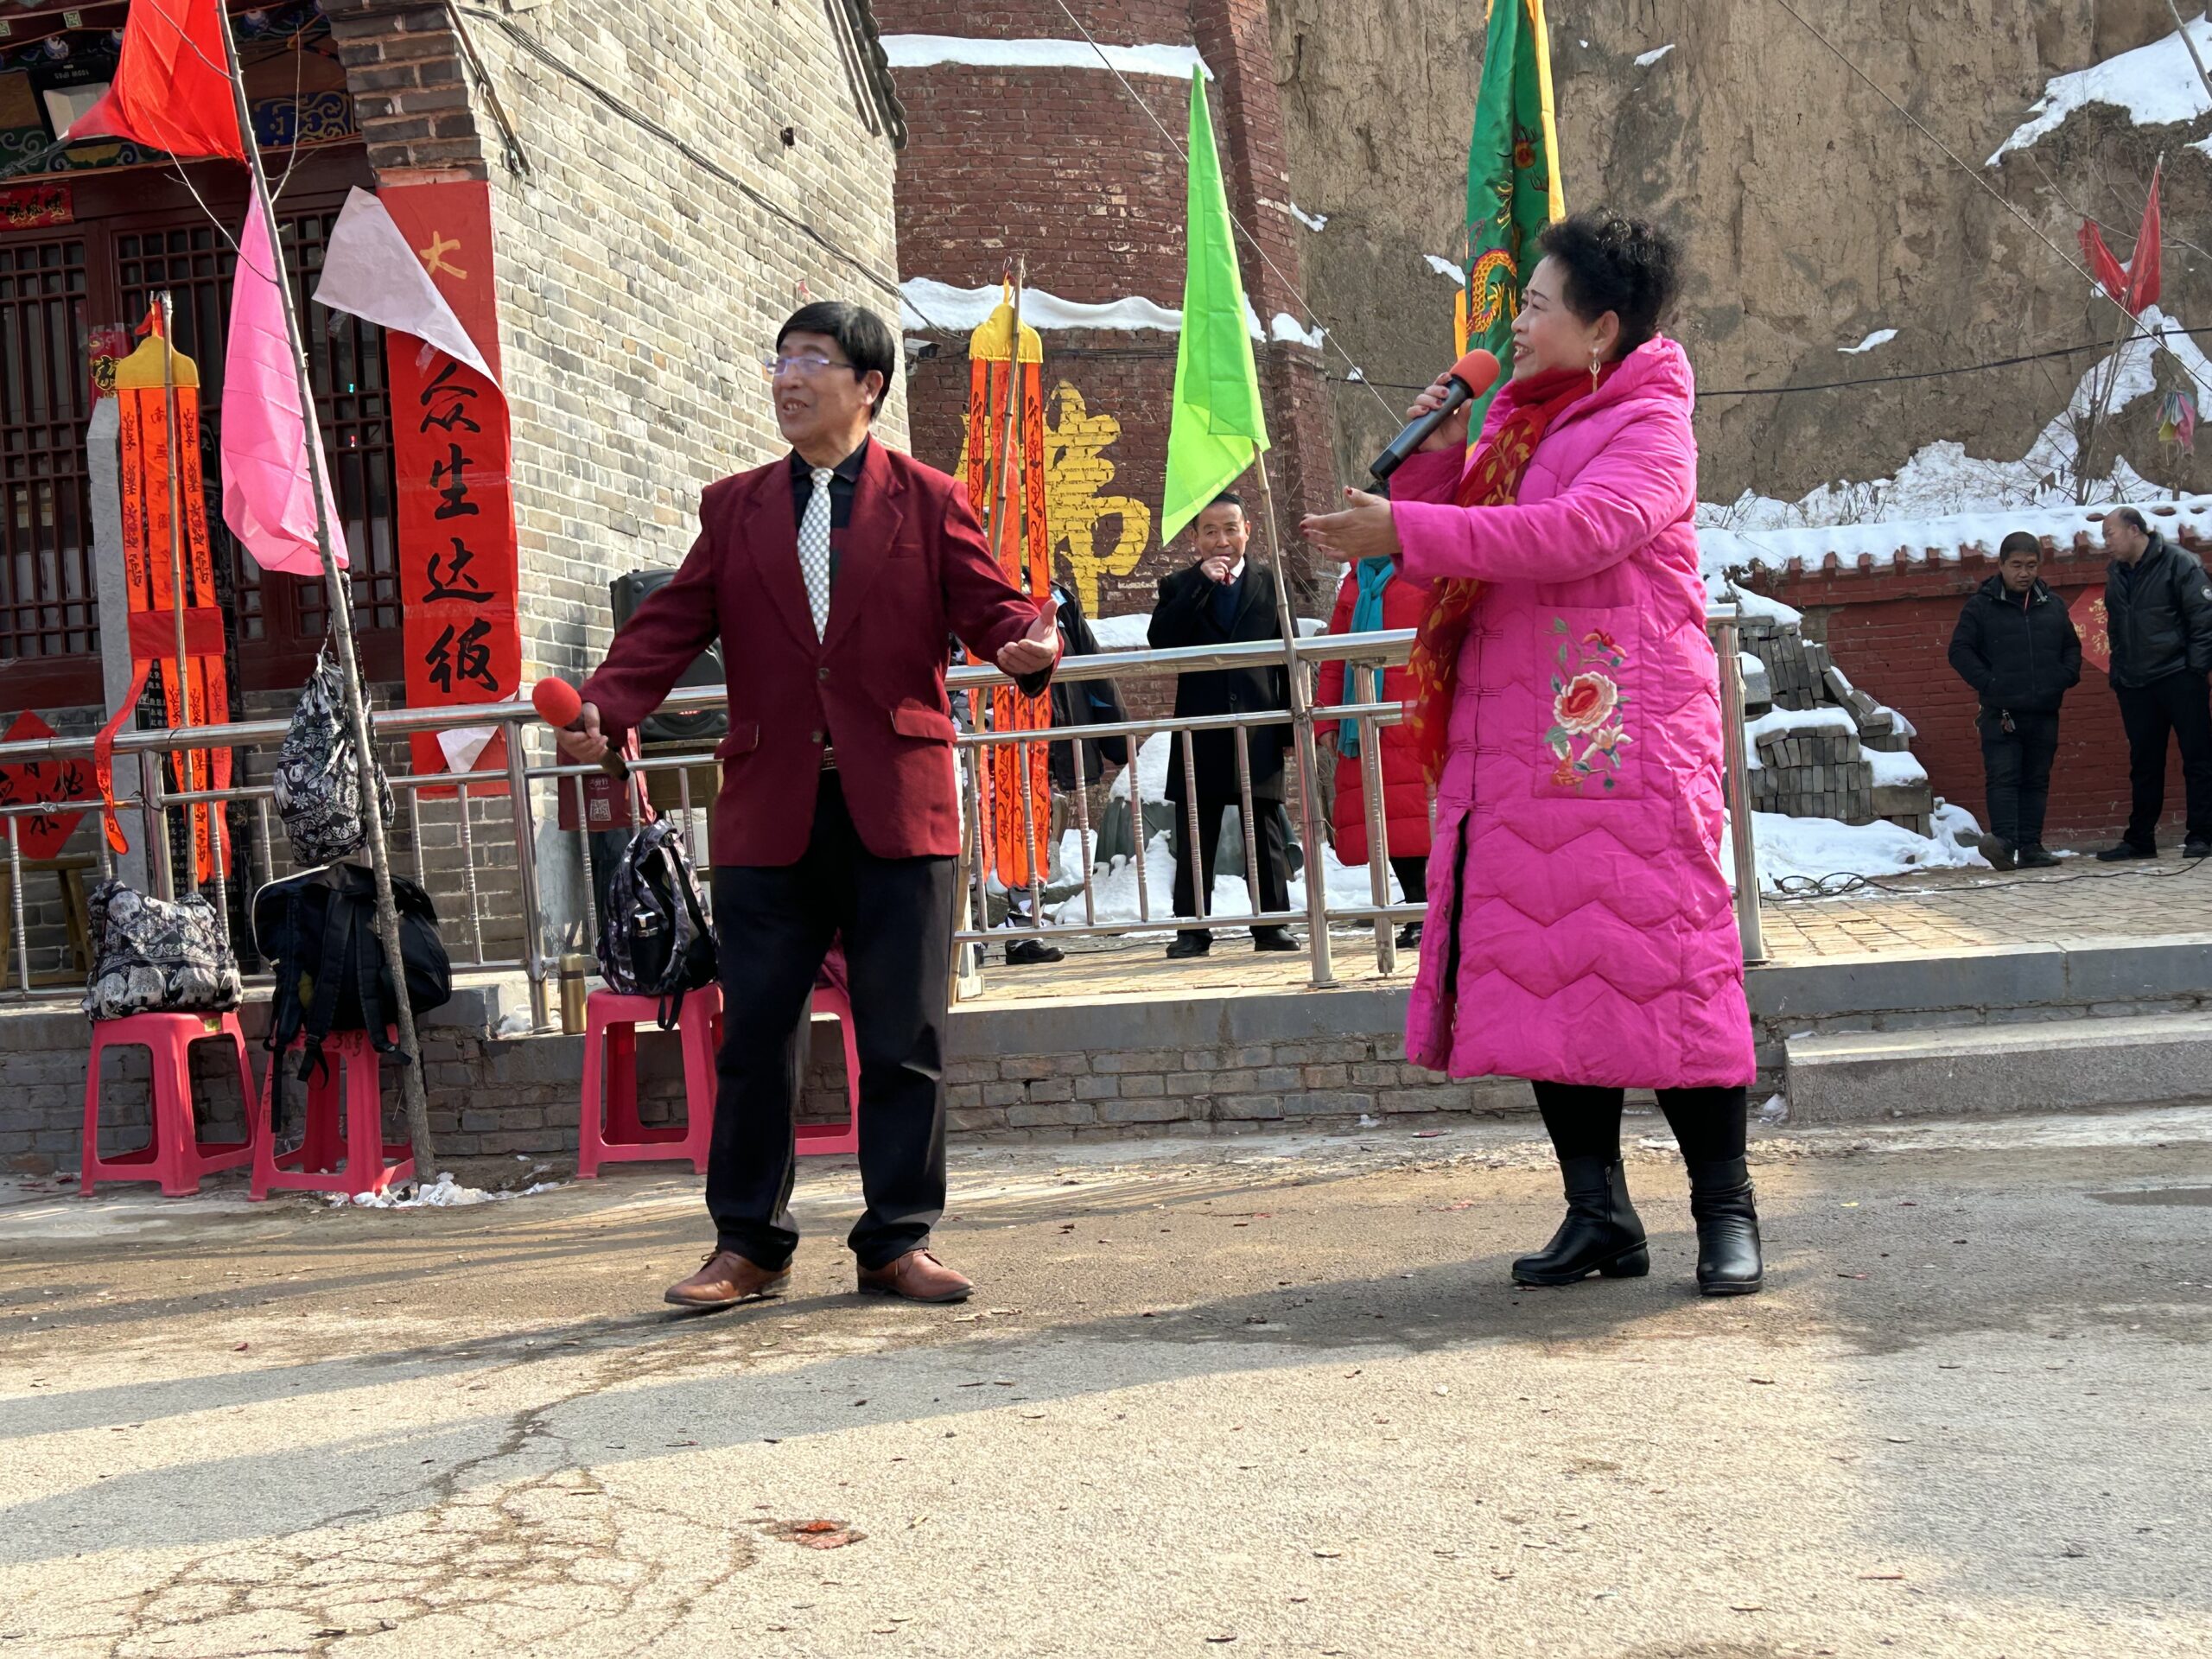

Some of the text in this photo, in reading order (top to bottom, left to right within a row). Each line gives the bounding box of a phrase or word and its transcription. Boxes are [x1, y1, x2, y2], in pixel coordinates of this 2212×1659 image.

[420, 230, 467, 280] 大
[420, 362, 499, 704] 众生达彼
